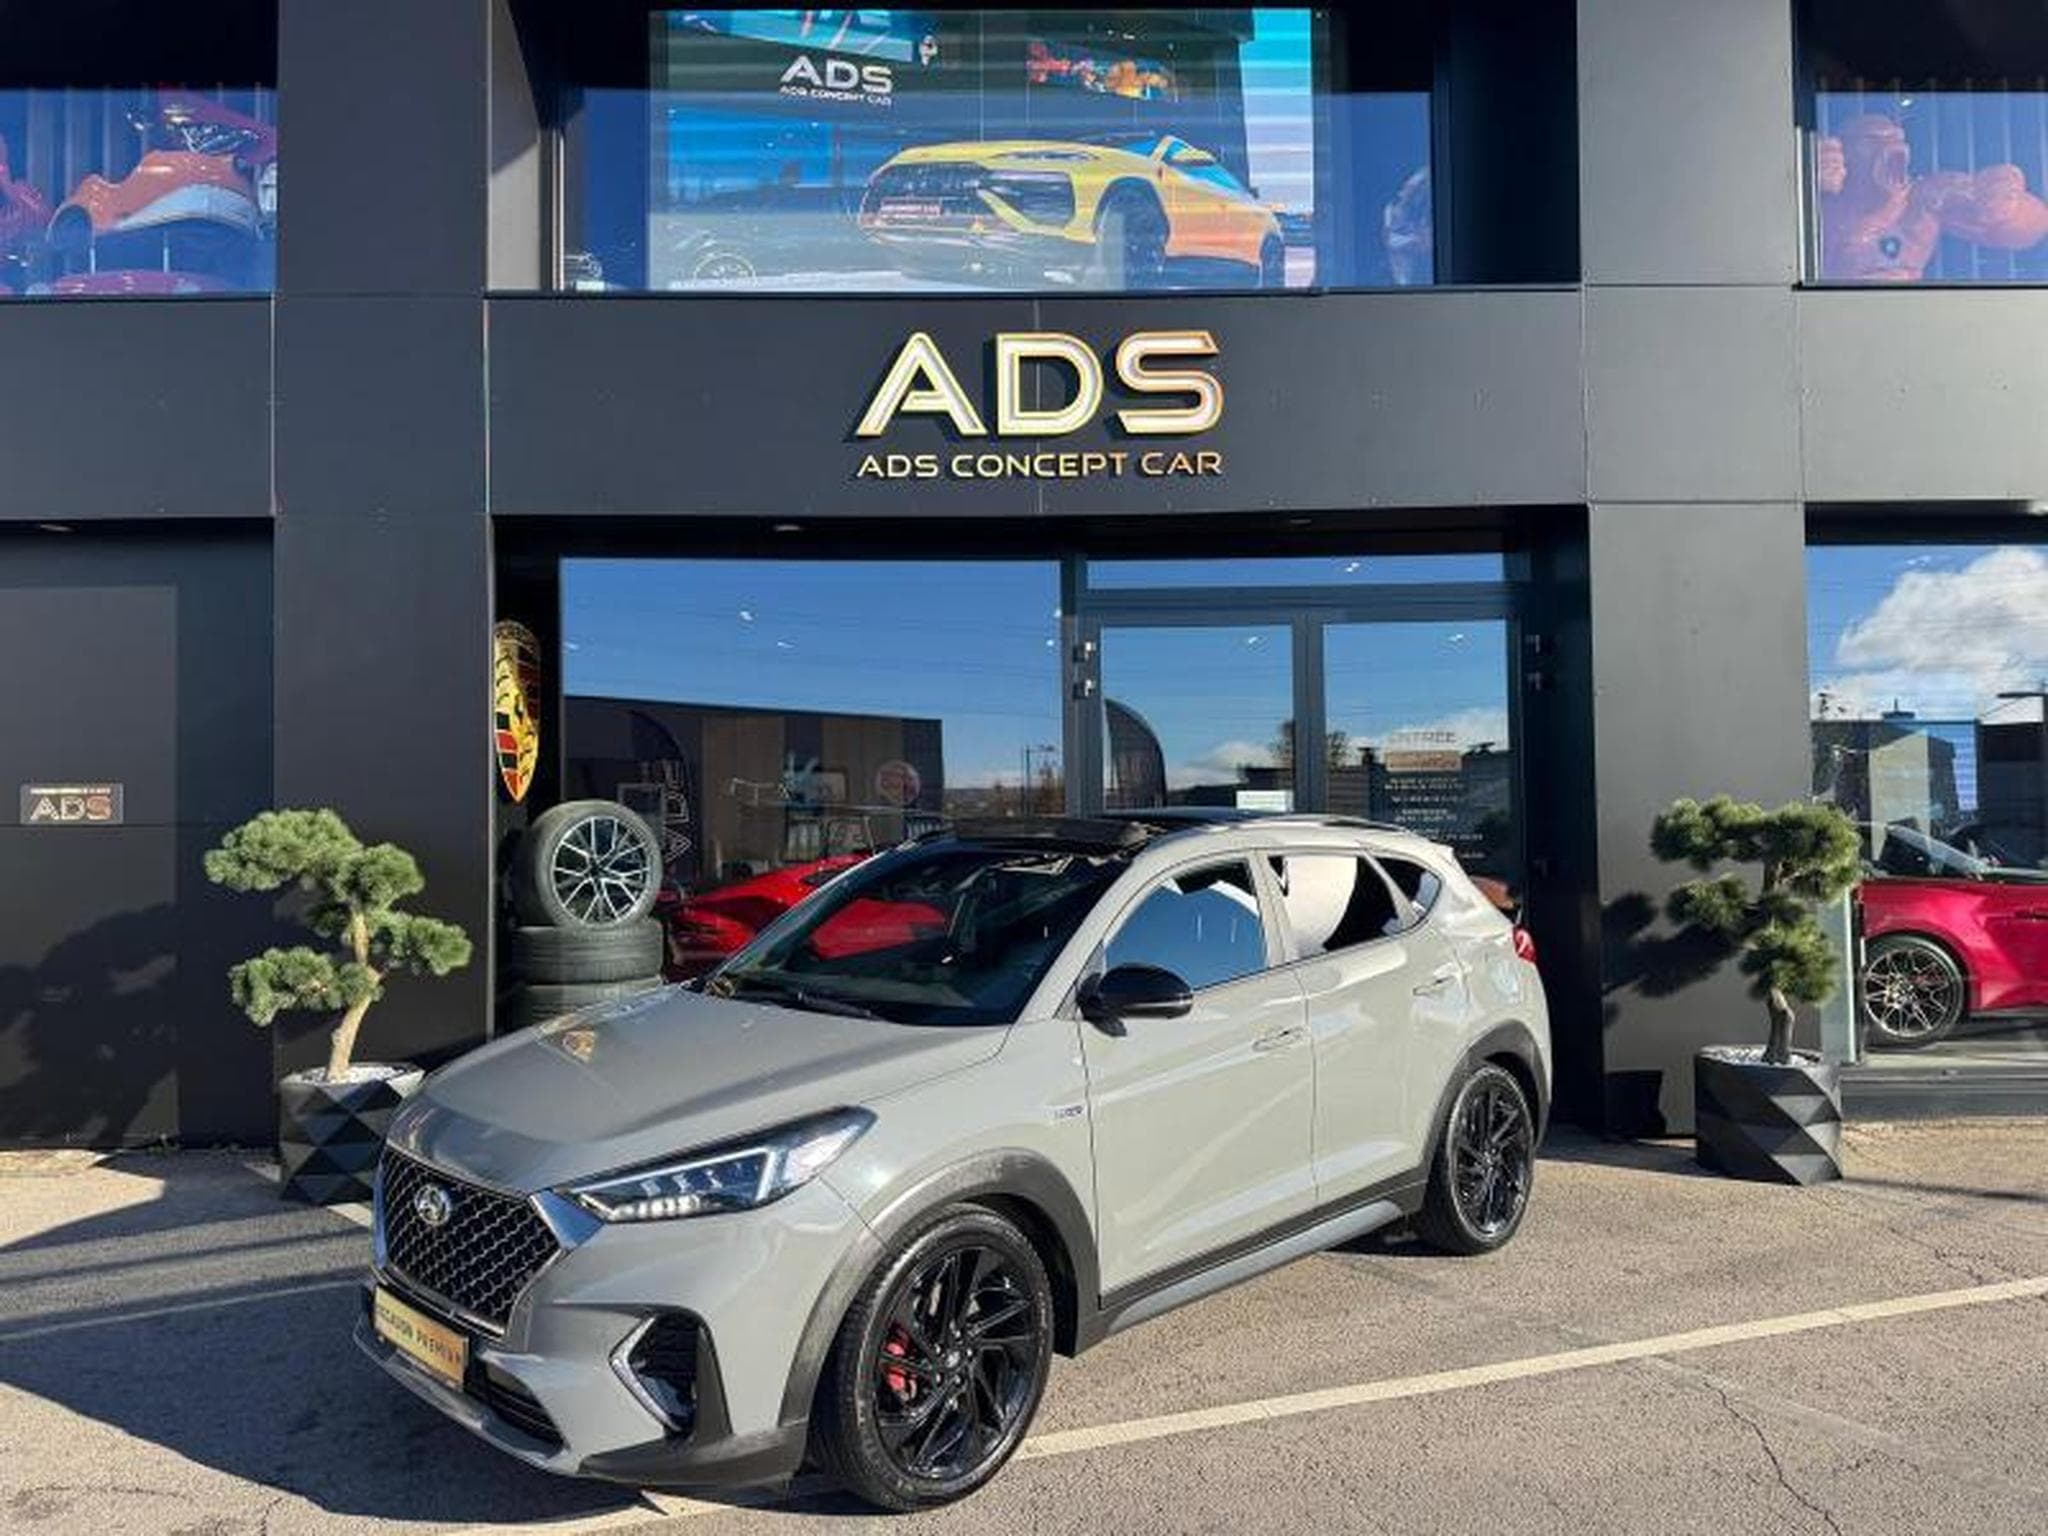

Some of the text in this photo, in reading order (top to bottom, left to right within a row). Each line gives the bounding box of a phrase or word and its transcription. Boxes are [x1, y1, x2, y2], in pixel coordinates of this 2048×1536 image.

[780, 55, 893, 93] ADS
[856, 331, 1224, 436] ADS
[856, 451, 1223, 478] ADS CONCEPT CAR
[30, 795, 111, 820] ADS
